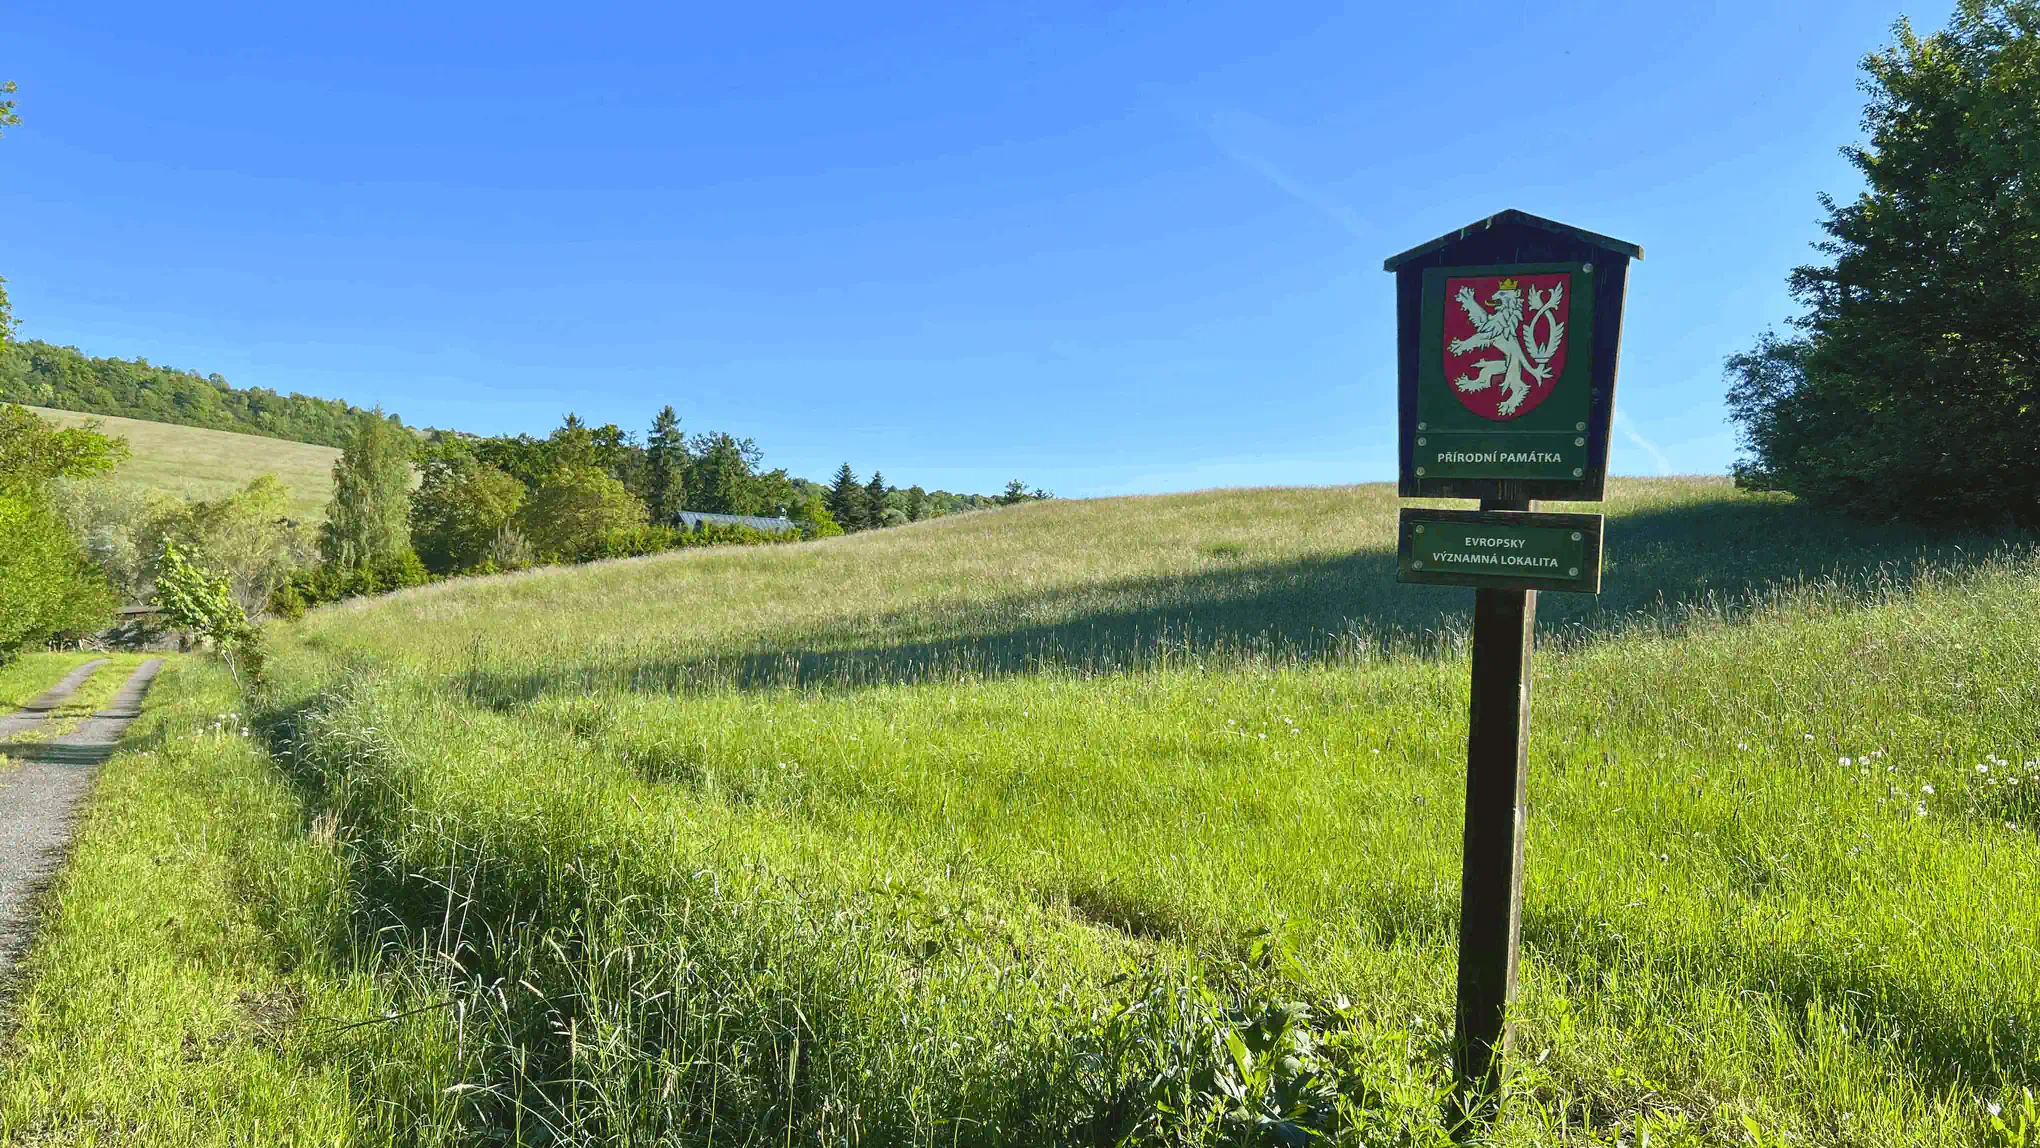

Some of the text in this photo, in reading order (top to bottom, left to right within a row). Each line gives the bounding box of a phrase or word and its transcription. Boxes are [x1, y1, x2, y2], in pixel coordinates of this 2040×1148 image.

[1437, 450, 1561, 463] PŘÍRODNÍ PAMÁTKA
[1465, 537, 1526, 549] EVROPSKY
[1432, 551, 1558, 568] VÝZNAMNÁ LOKALITA
